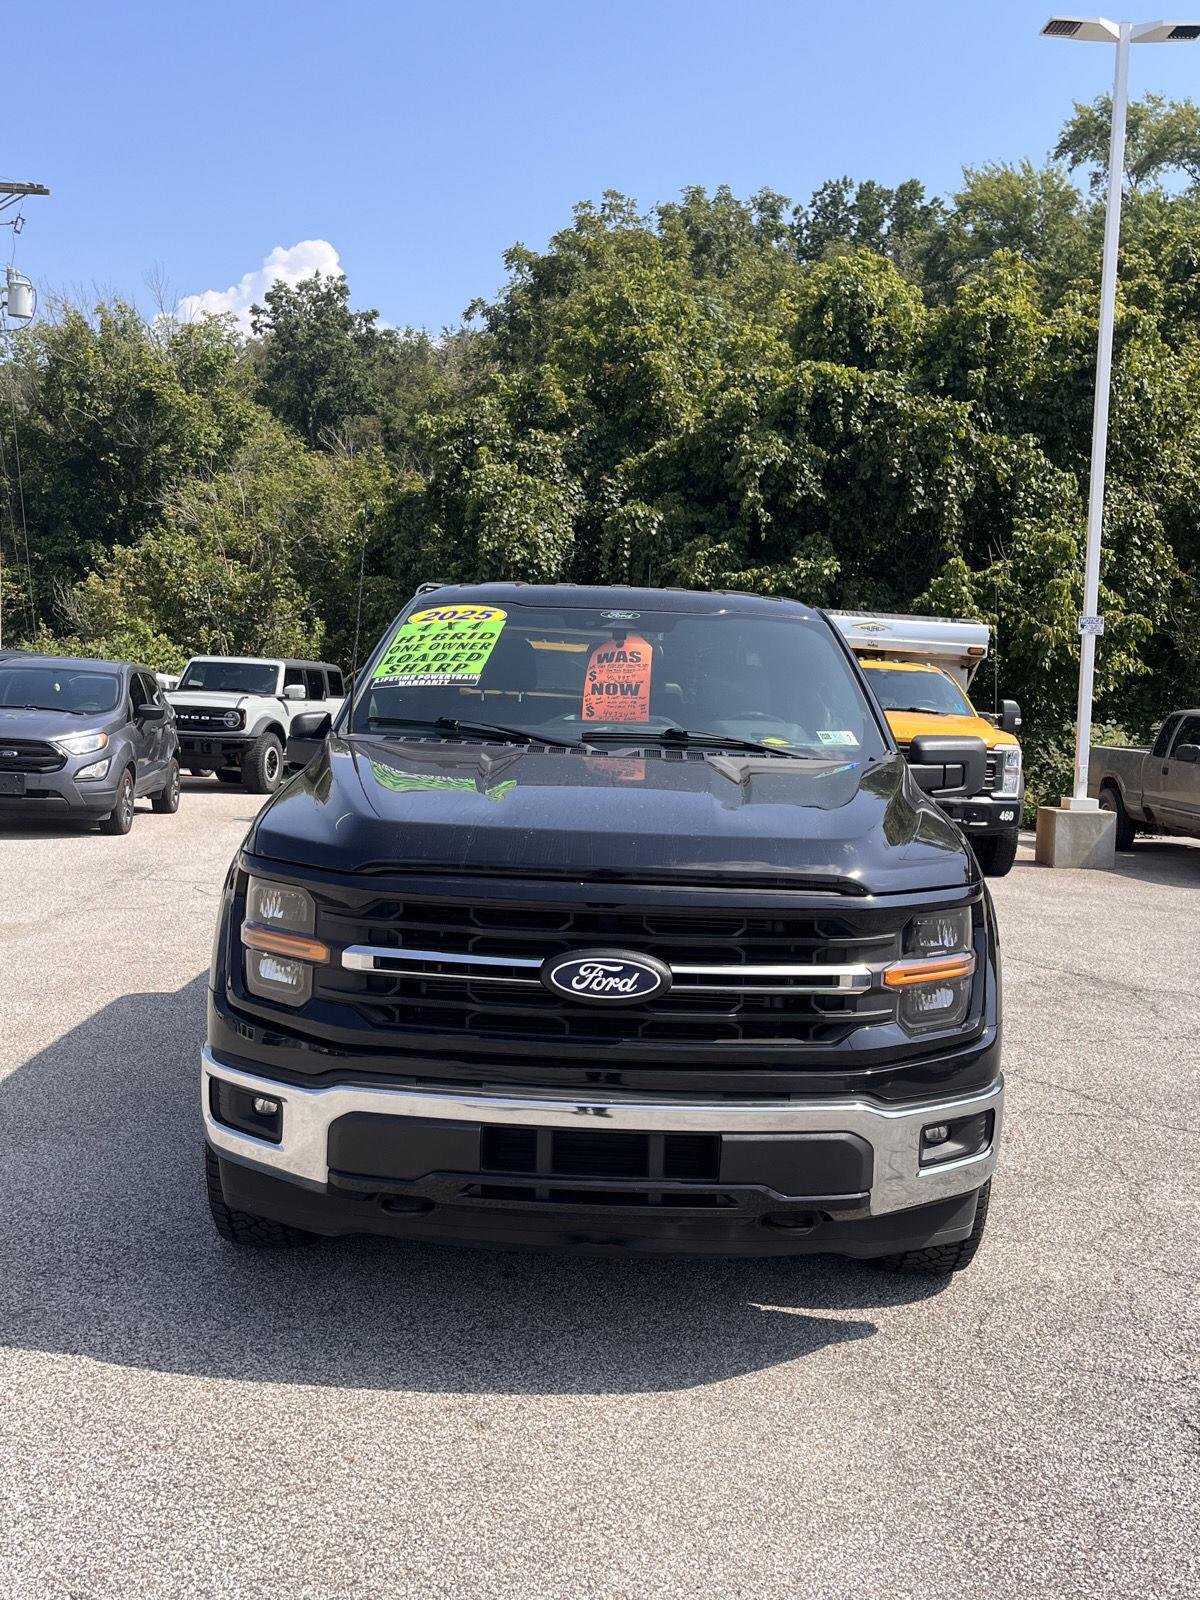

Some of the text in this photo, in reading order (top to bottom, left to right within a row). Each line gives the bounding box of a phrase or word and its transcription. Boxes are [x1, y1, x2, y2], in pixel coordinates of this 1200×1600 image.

[418, 610, 497, 622] 2025
[418, 622, 434, 632] 4
[467, 620, 485, 631] 4
[396, 632, 496, 645] HYBRID
[388, 642, 493, 655] ONE OWNER
[383, 652, 485, 665] LOADED
[597, 650, 642, 664] WAS
[384, 663, 469, 675] SHARP
[375, 675, 416, 684] LIFETIME
[589, 670, 597, 682] $
[398, 679, 451, 687] WARRANTY
[591, 683, 641, 696] NOW
[586, 705, 595, 718] $
[999, 810, 1014, 822] 460
[571, 963, 641, 993] Ford
